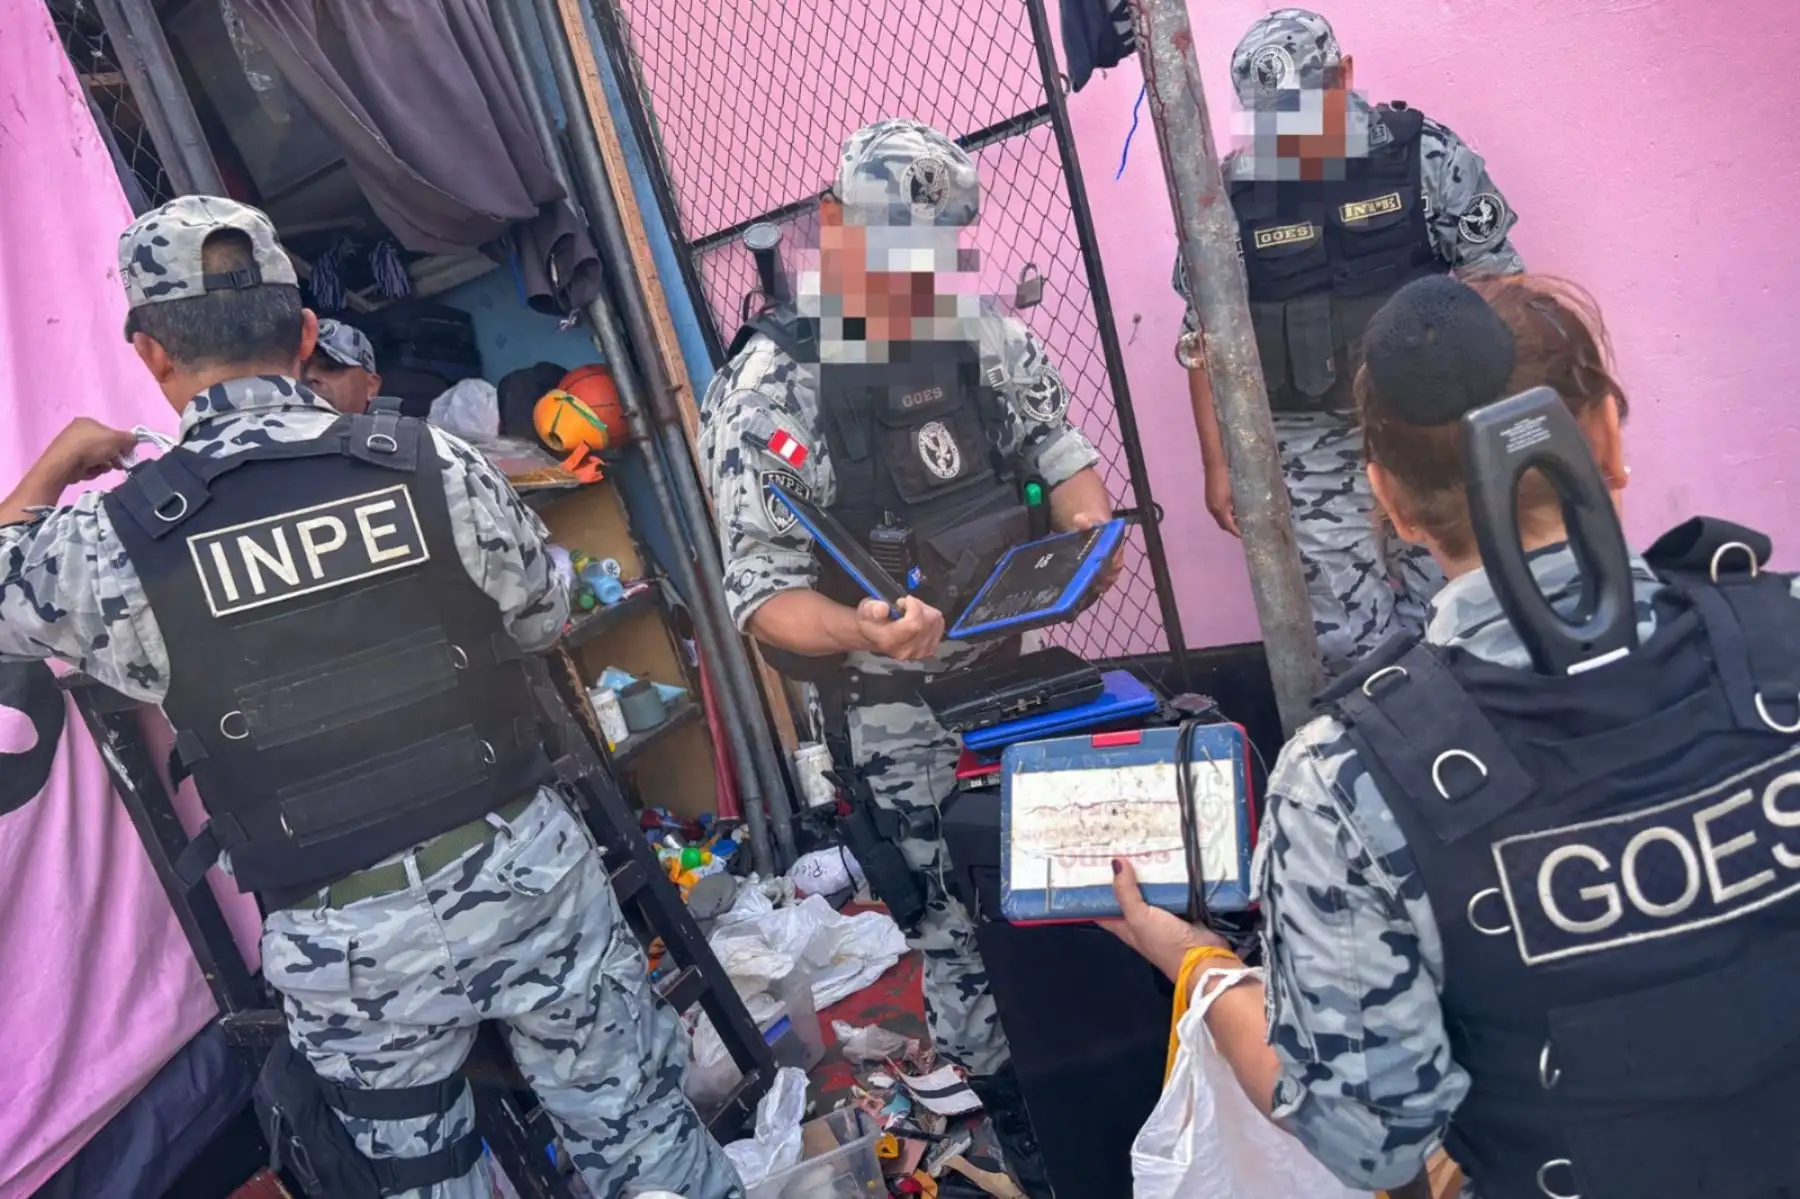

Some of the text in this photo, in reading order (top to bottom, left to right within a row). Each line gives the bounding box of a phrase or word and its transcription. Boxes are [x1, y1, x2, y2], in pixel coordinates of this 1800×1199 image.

[1344, 197, 1397, 218] INPE
[1260, 226, 1309, 244] GOES
[902, 387, 943, 408] GOES
[209, 500, 411, 602] INPE
